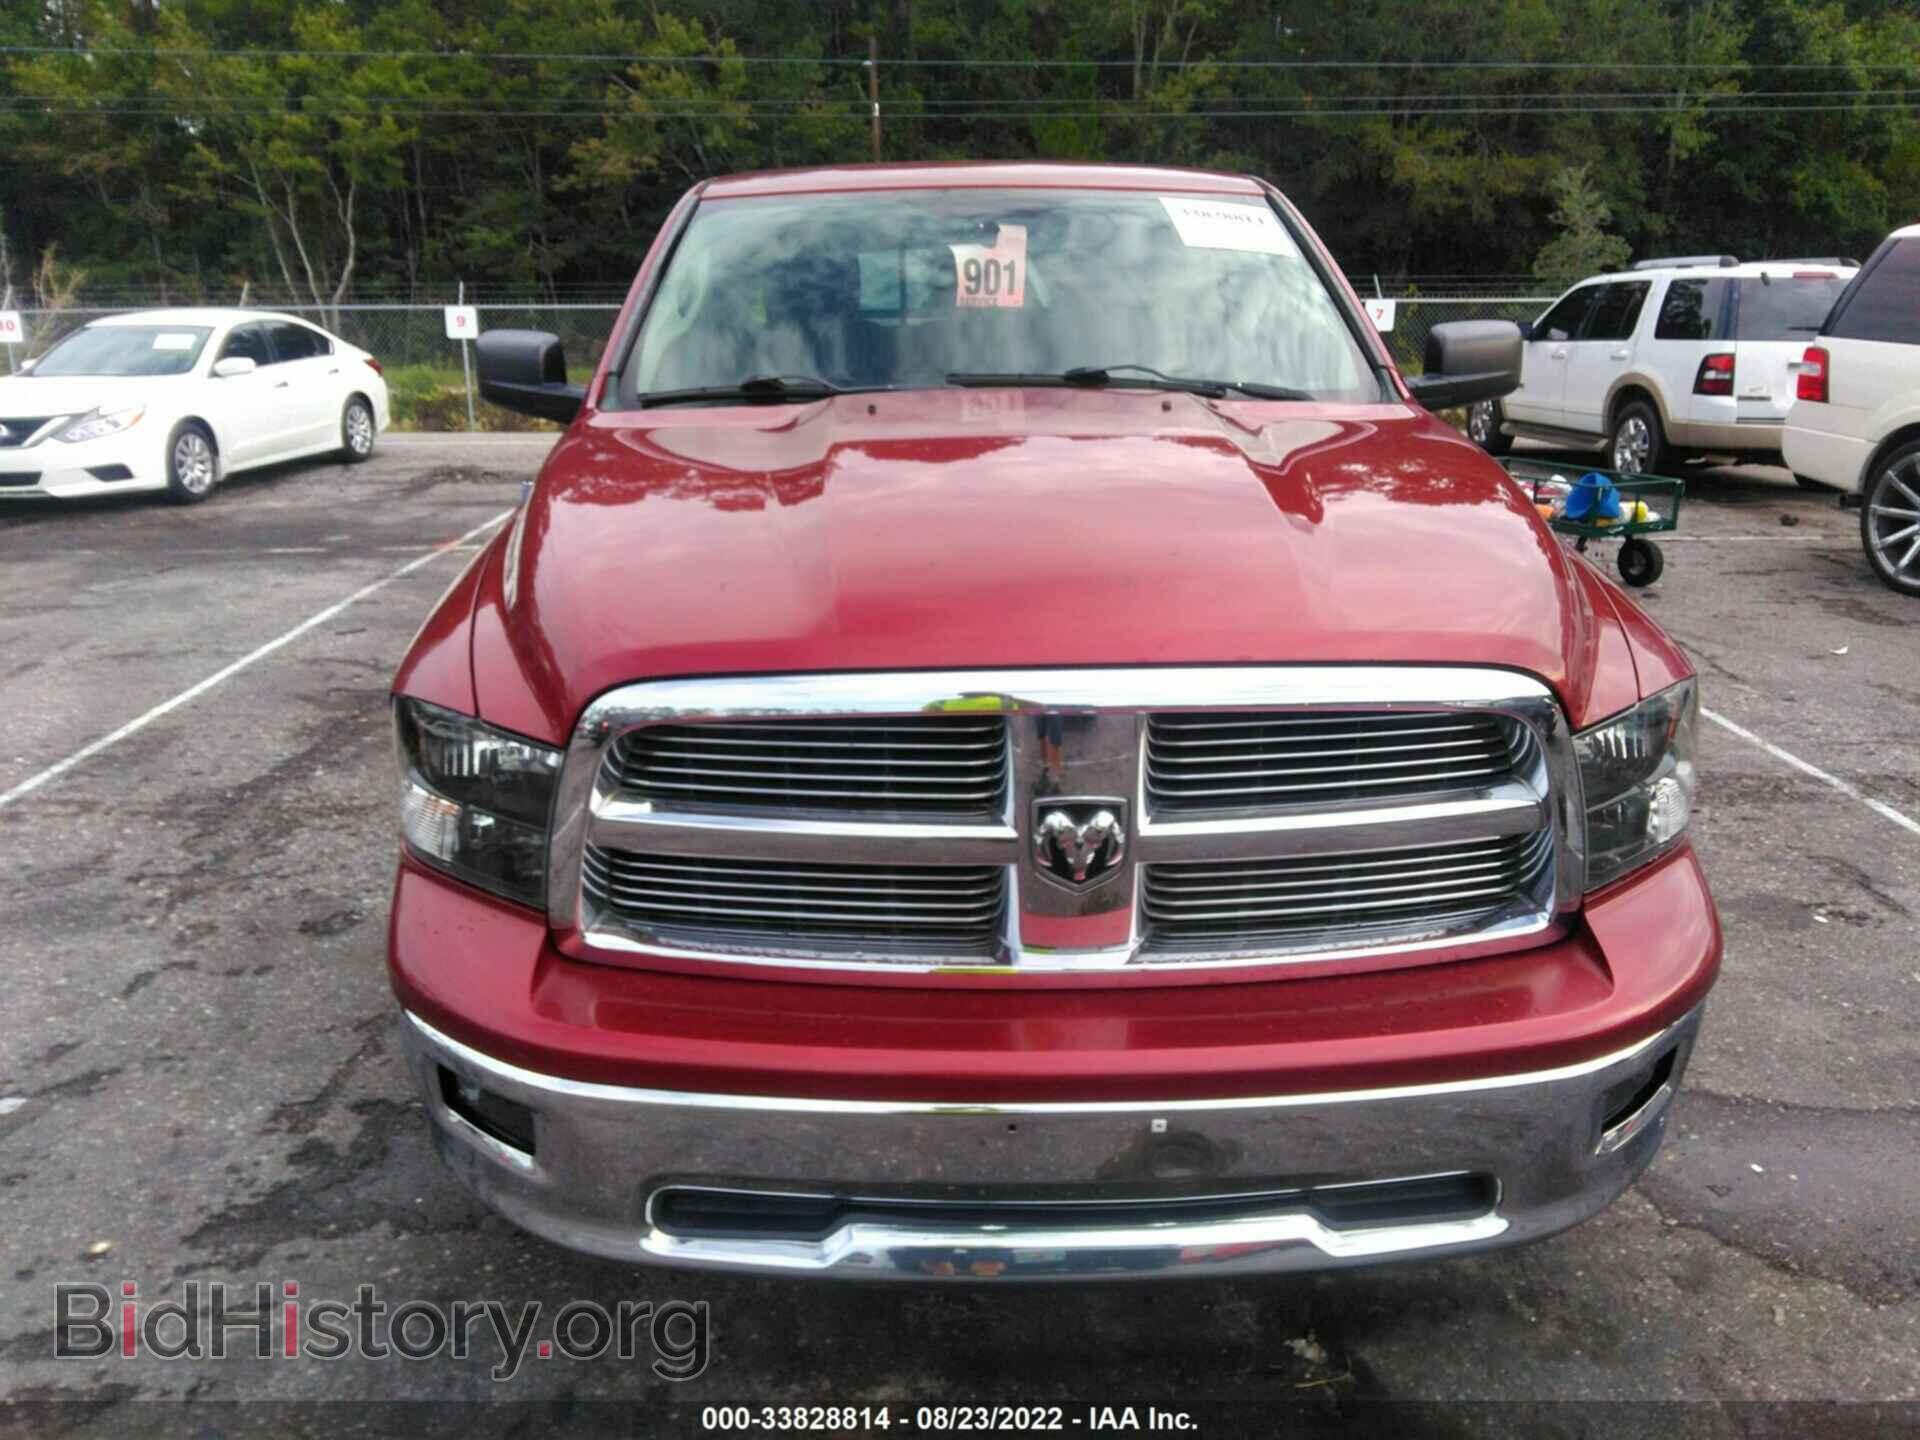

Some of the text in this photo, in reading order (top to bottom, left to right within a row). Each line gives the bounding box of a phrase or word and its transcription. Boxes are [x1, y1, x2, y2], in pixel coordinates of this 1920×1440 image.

[963, 258, 1016, 296] 901
[1375, 308, 1384, 320] 7
[456, 315, 466, 328] 9
